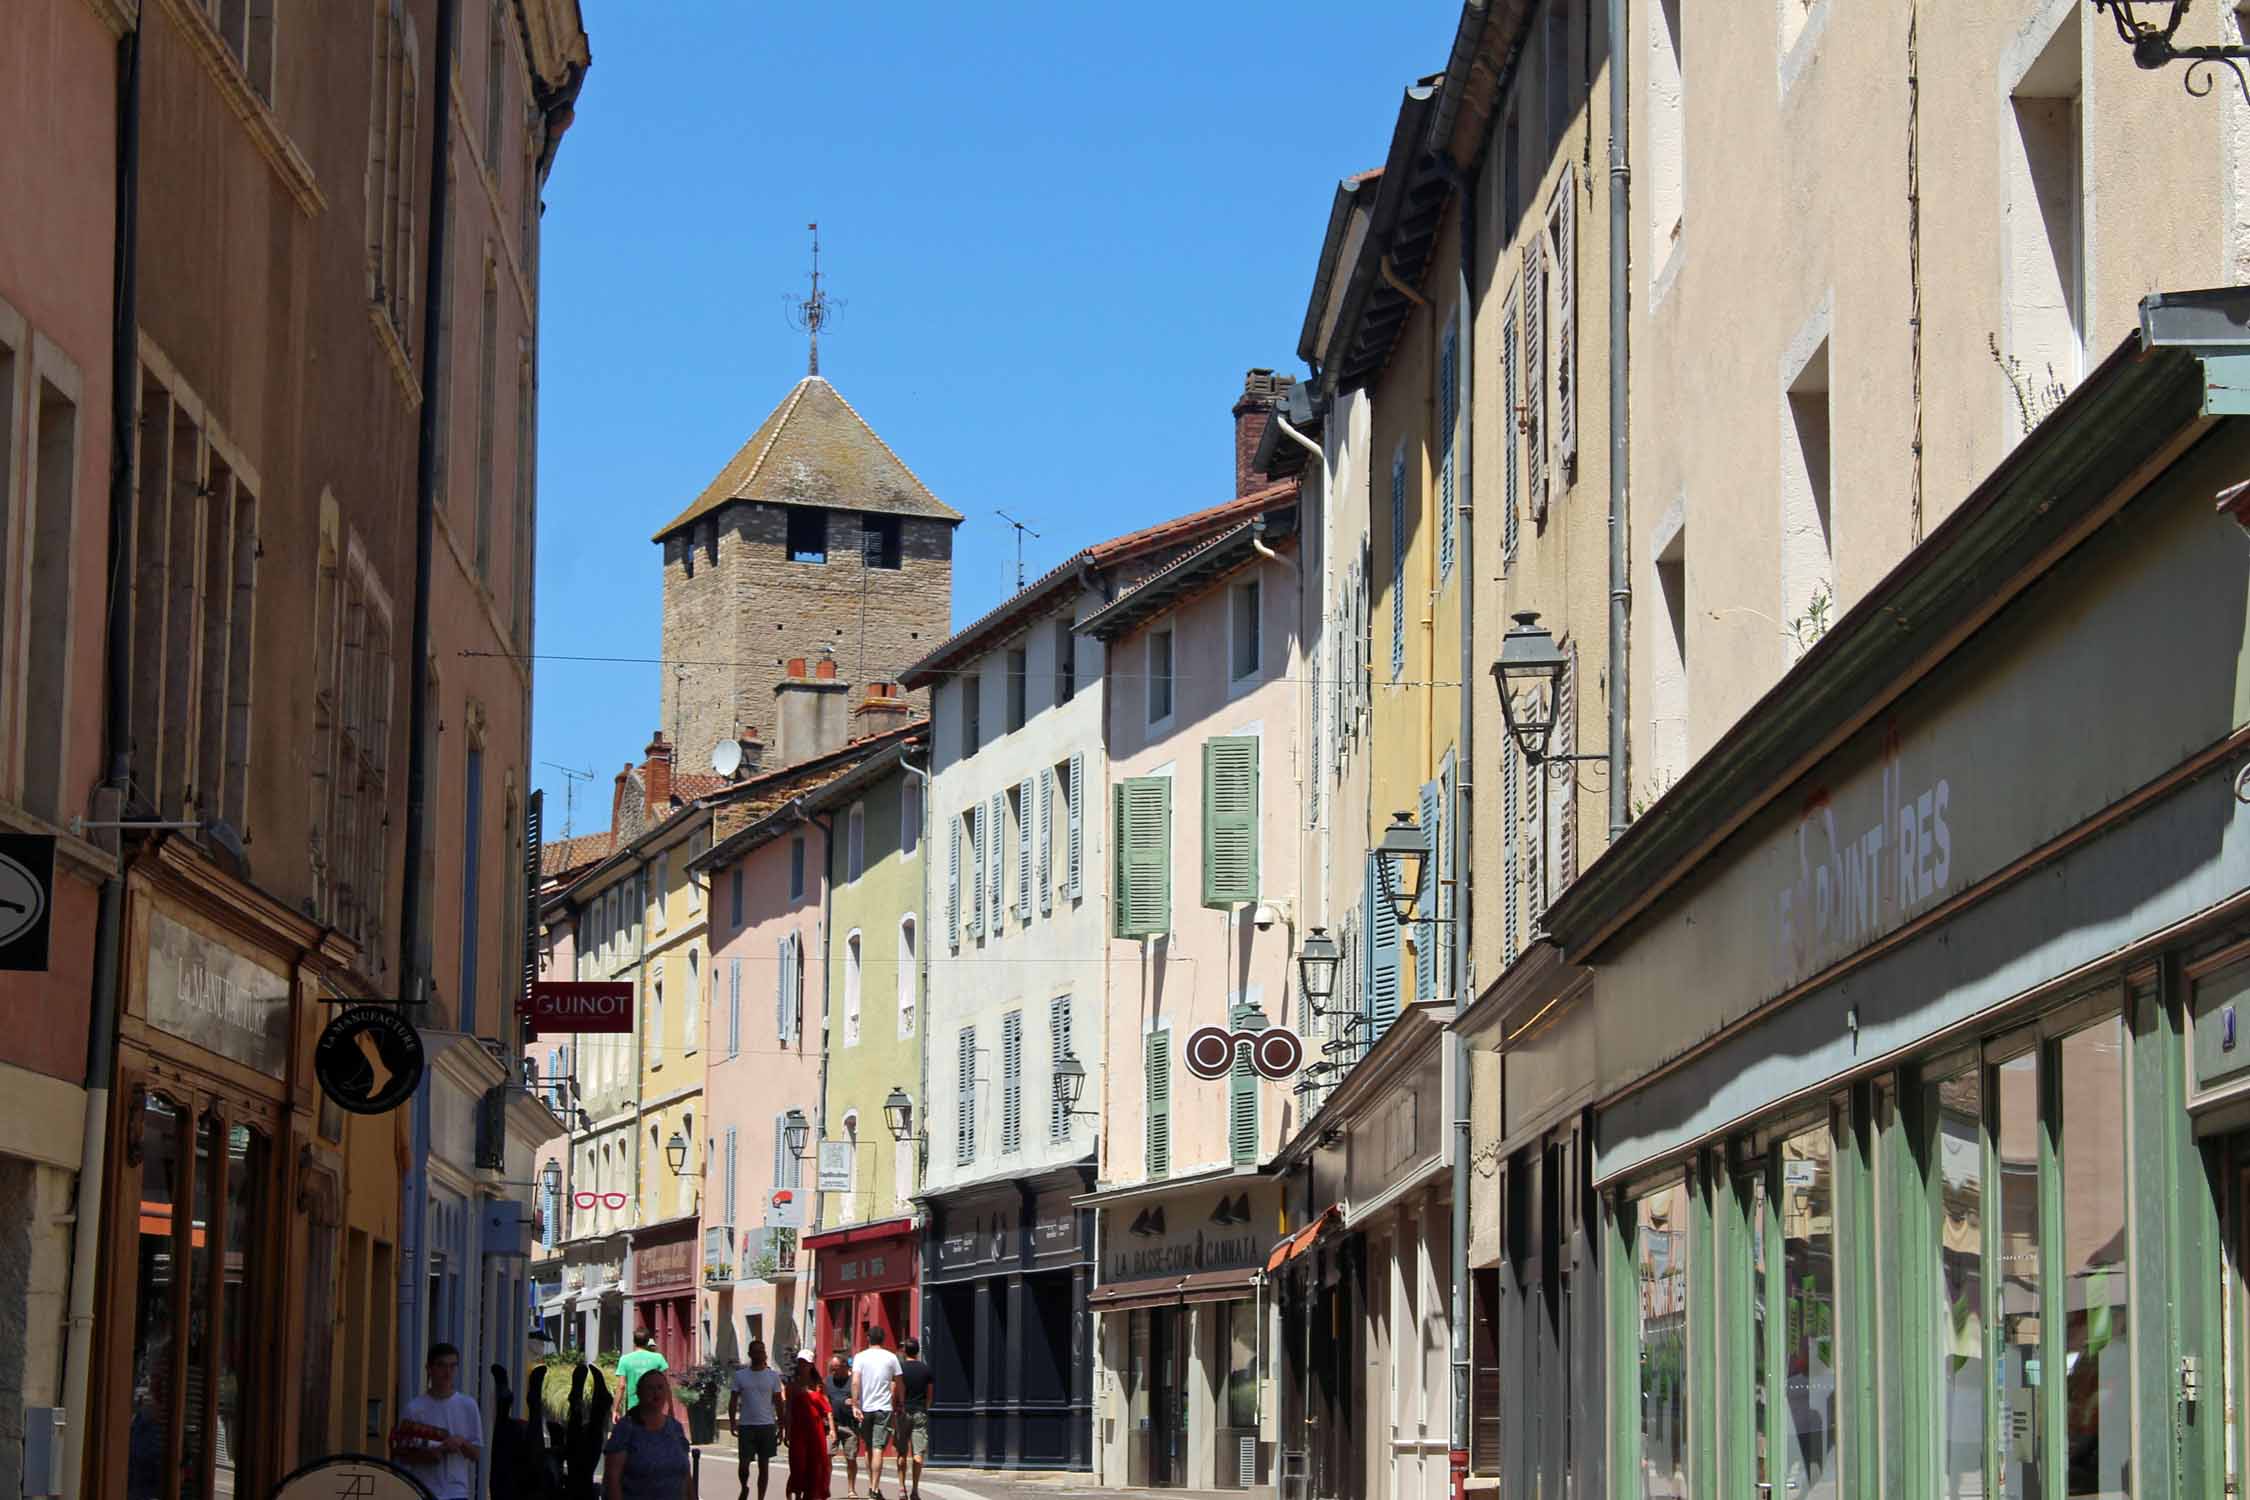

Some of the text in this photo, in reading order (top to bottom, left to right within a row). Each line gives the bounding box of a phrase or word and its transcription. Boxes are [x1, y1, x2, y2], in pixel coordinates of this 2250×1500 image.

[537, 995, 630, 1015] GUINOT
[1114, 1252, 1127, 1277] LA
[1206, 1235, 1258, 1265] CANNATA
